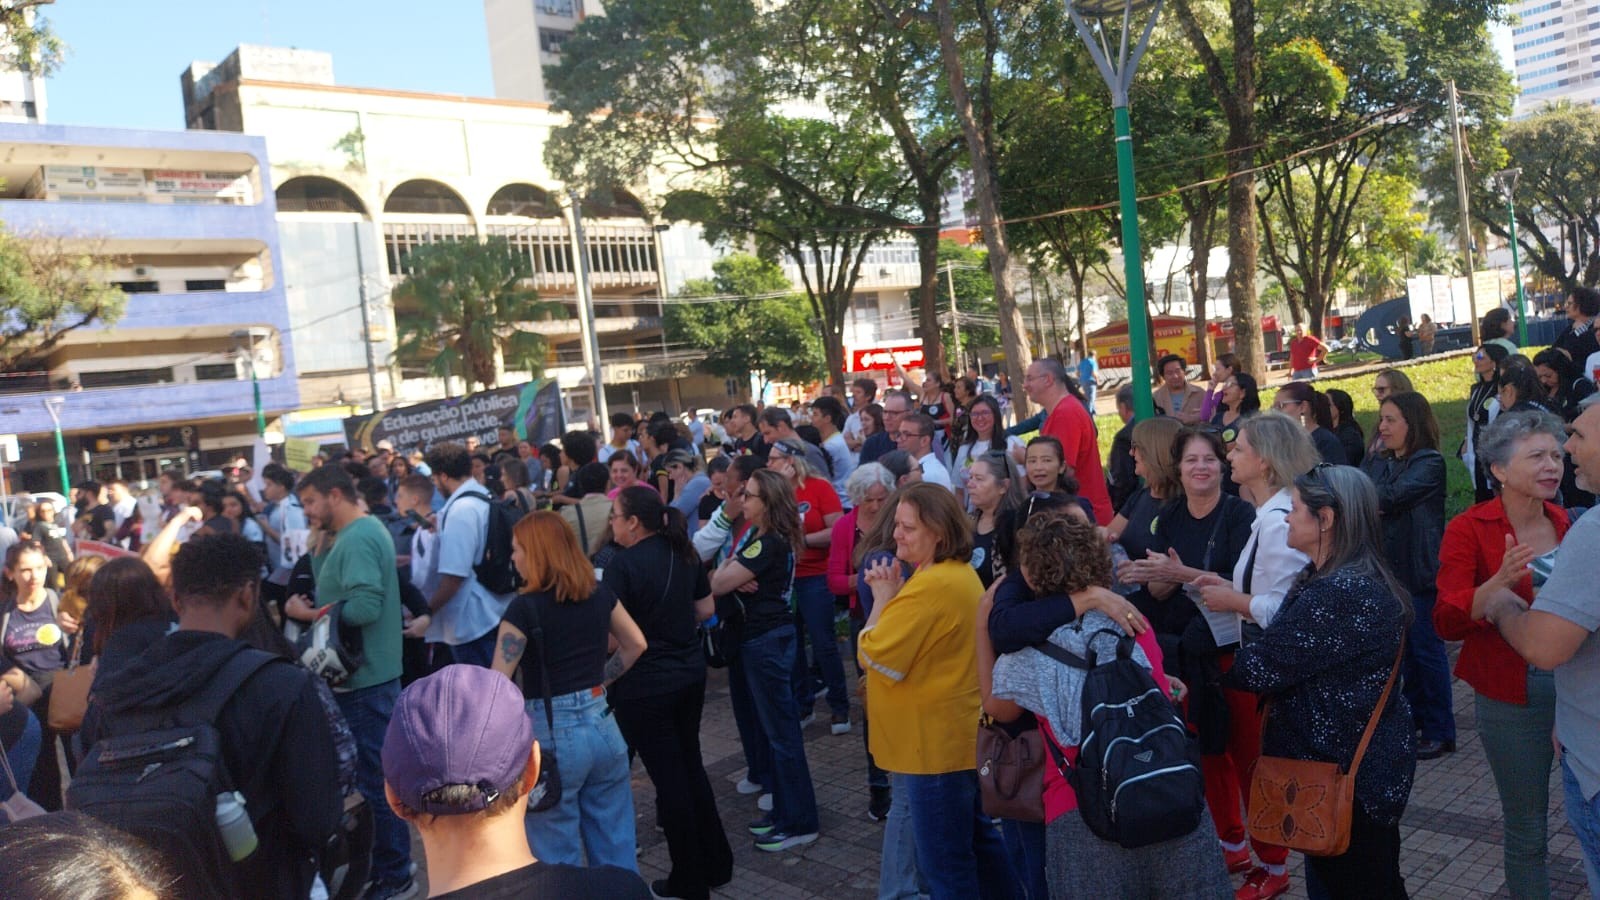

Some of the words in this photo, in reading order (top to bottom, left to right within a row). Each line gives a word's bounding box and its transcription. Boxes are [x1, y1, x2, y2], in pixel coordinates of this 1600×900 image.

[382, 404, 459, 431] Educação
[461, 395, 518, 423] pública
[399, 429, 419, 444] de
[420, 414, 502, 443] qualidade.
